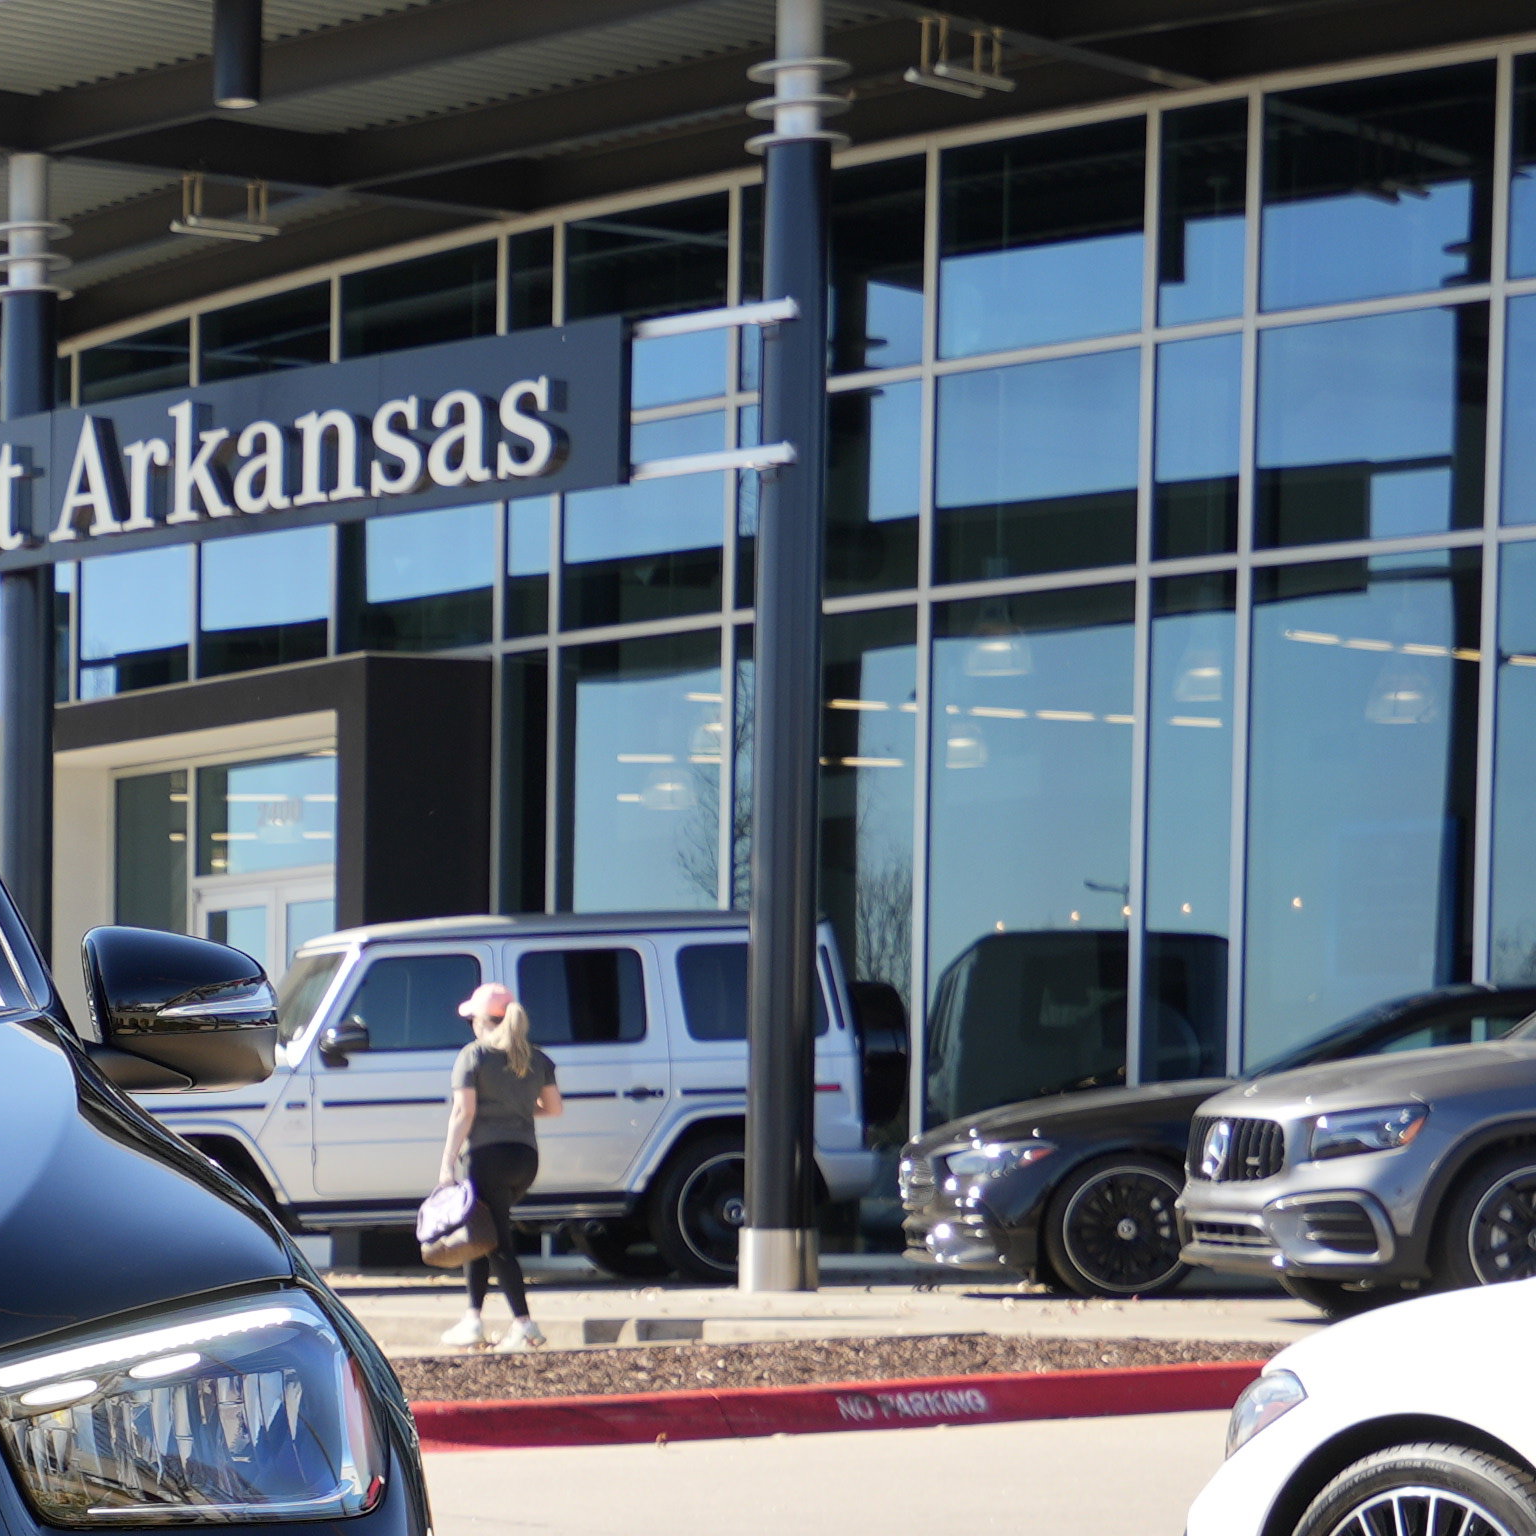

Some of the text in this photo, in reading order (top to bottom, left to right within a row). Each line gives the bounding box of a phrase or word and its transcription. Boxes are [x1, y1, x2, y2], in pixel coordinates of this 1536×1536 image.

[49, 375, 557, 542] Arkansas
[835, 1388, 988, 1423] NO PARKING
